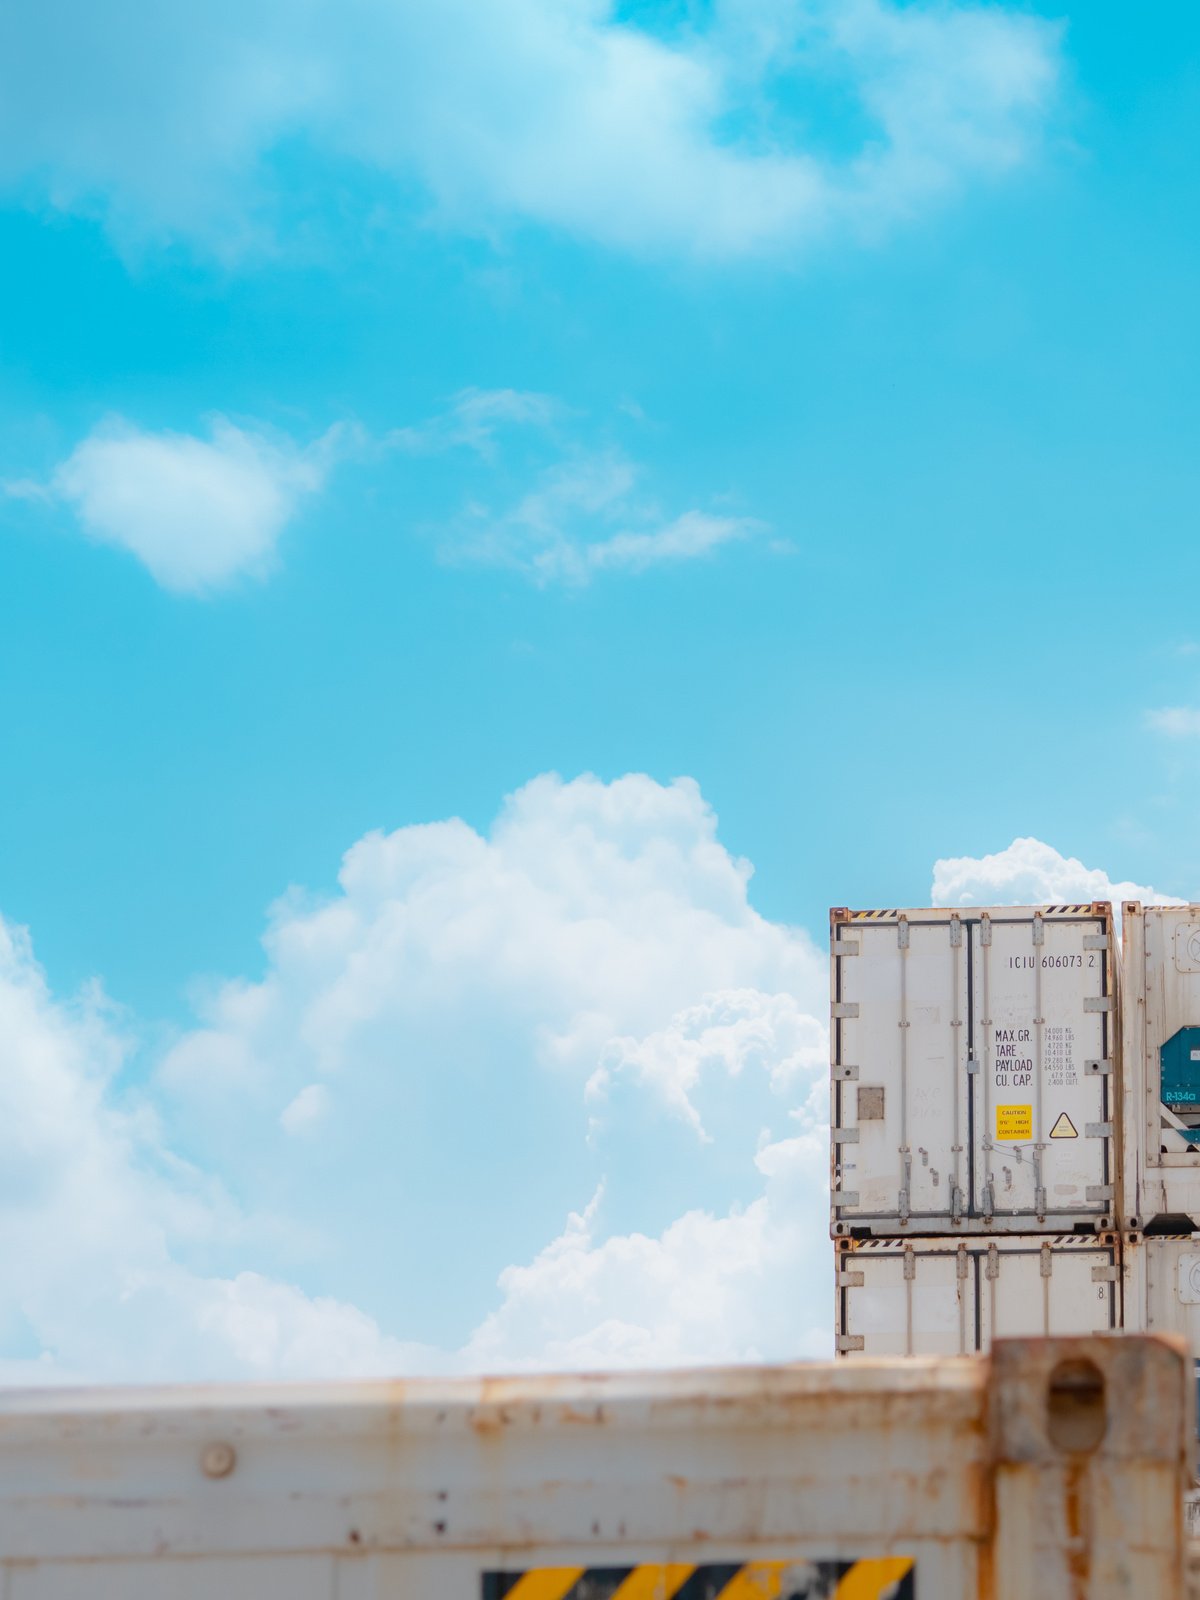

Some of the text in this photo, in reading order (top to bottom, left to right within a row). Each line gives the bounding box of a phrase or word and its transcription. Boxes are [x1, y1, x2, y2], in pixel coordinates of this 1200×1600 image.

[1009, 955, 1094, 969] ICIU 606073 2
[995, 1044, 1017, 1057] TARE
[995, 1059, 1033, 1072] PAYLOAD
[995, 1074, 1010, 1087] CU.
[1013, 1073, 1033, 1087] CAP.
[1166, 1091, 1196, 1101] R-134a
[1098, 1286, 1104, 1299] 8
